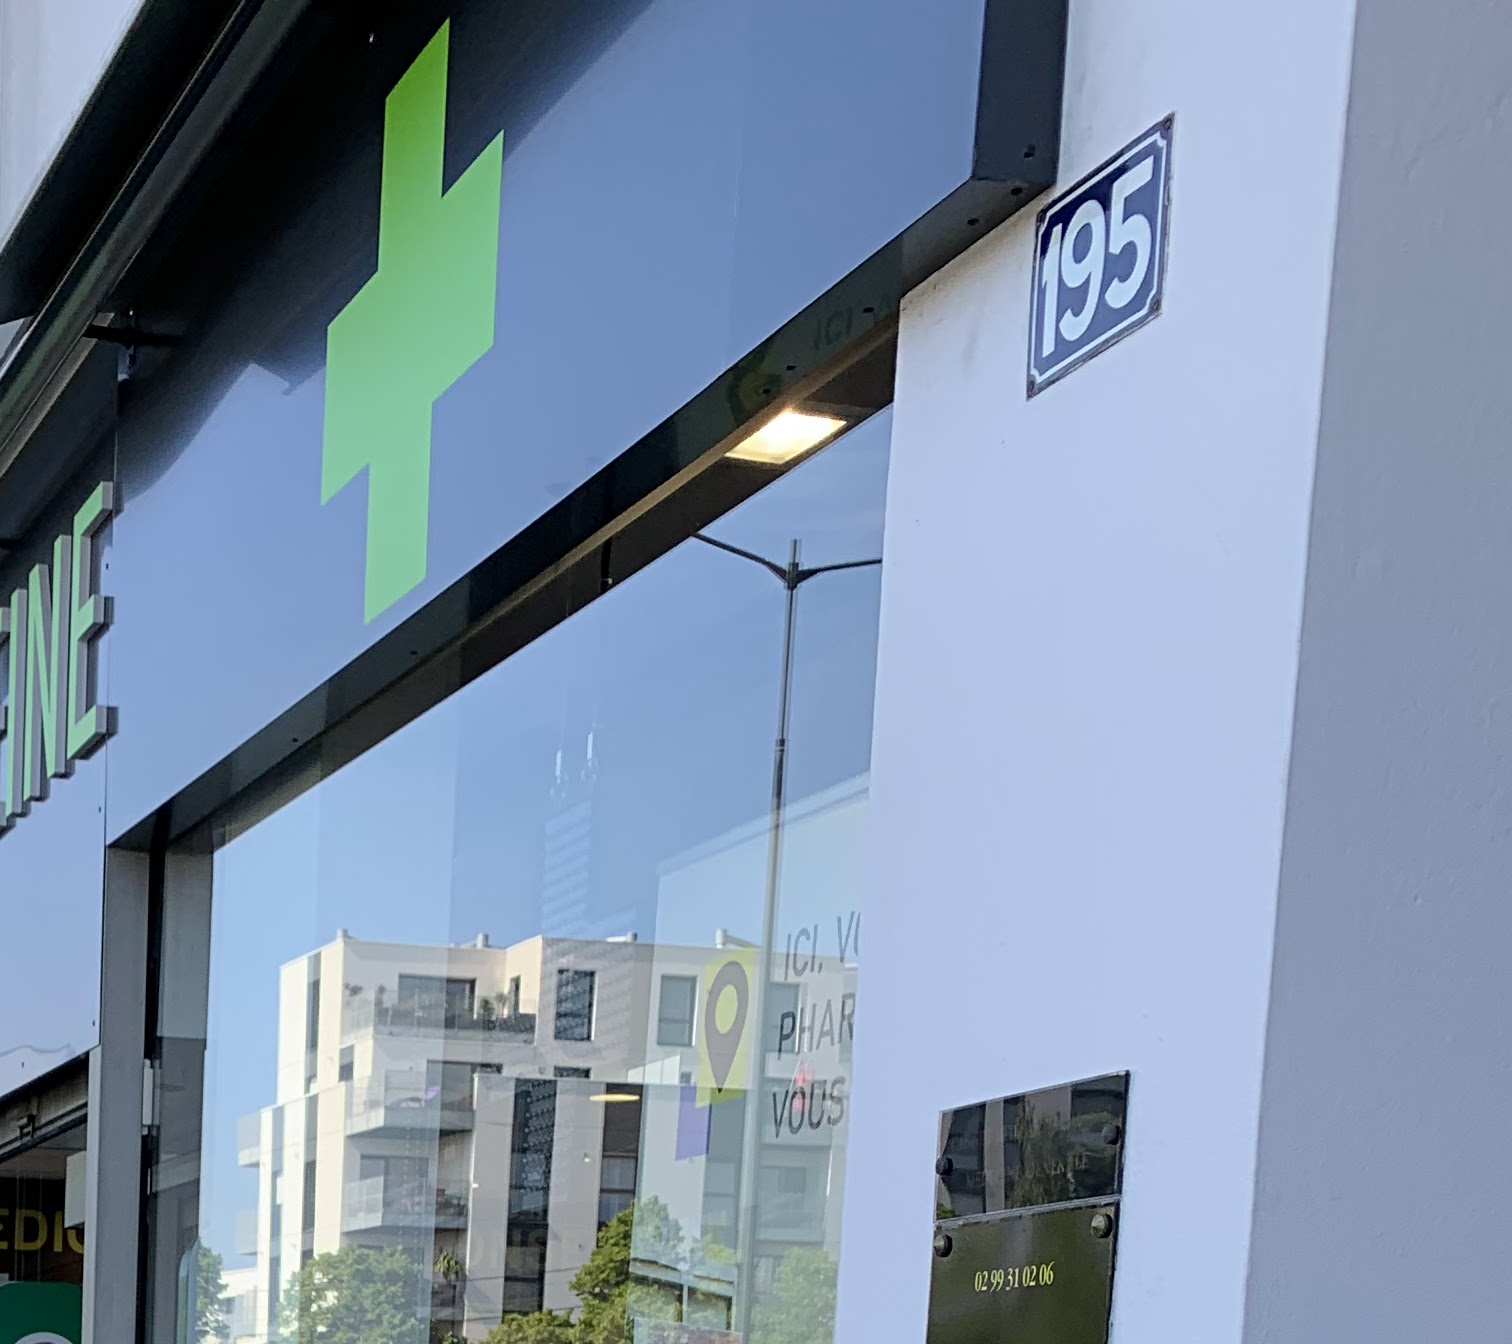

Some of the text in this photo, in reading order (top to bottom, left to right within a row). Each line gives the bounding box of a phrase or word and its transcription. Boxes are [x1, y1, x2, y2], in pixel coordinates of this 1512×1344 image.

[1041, 154, 1155, 358] 195
[777, 992, 857, 1061] PHAR
[772, 1075, 847, 1139] VOUS
[974, 1261, 1055, 1293] 02 99 31 02 06
